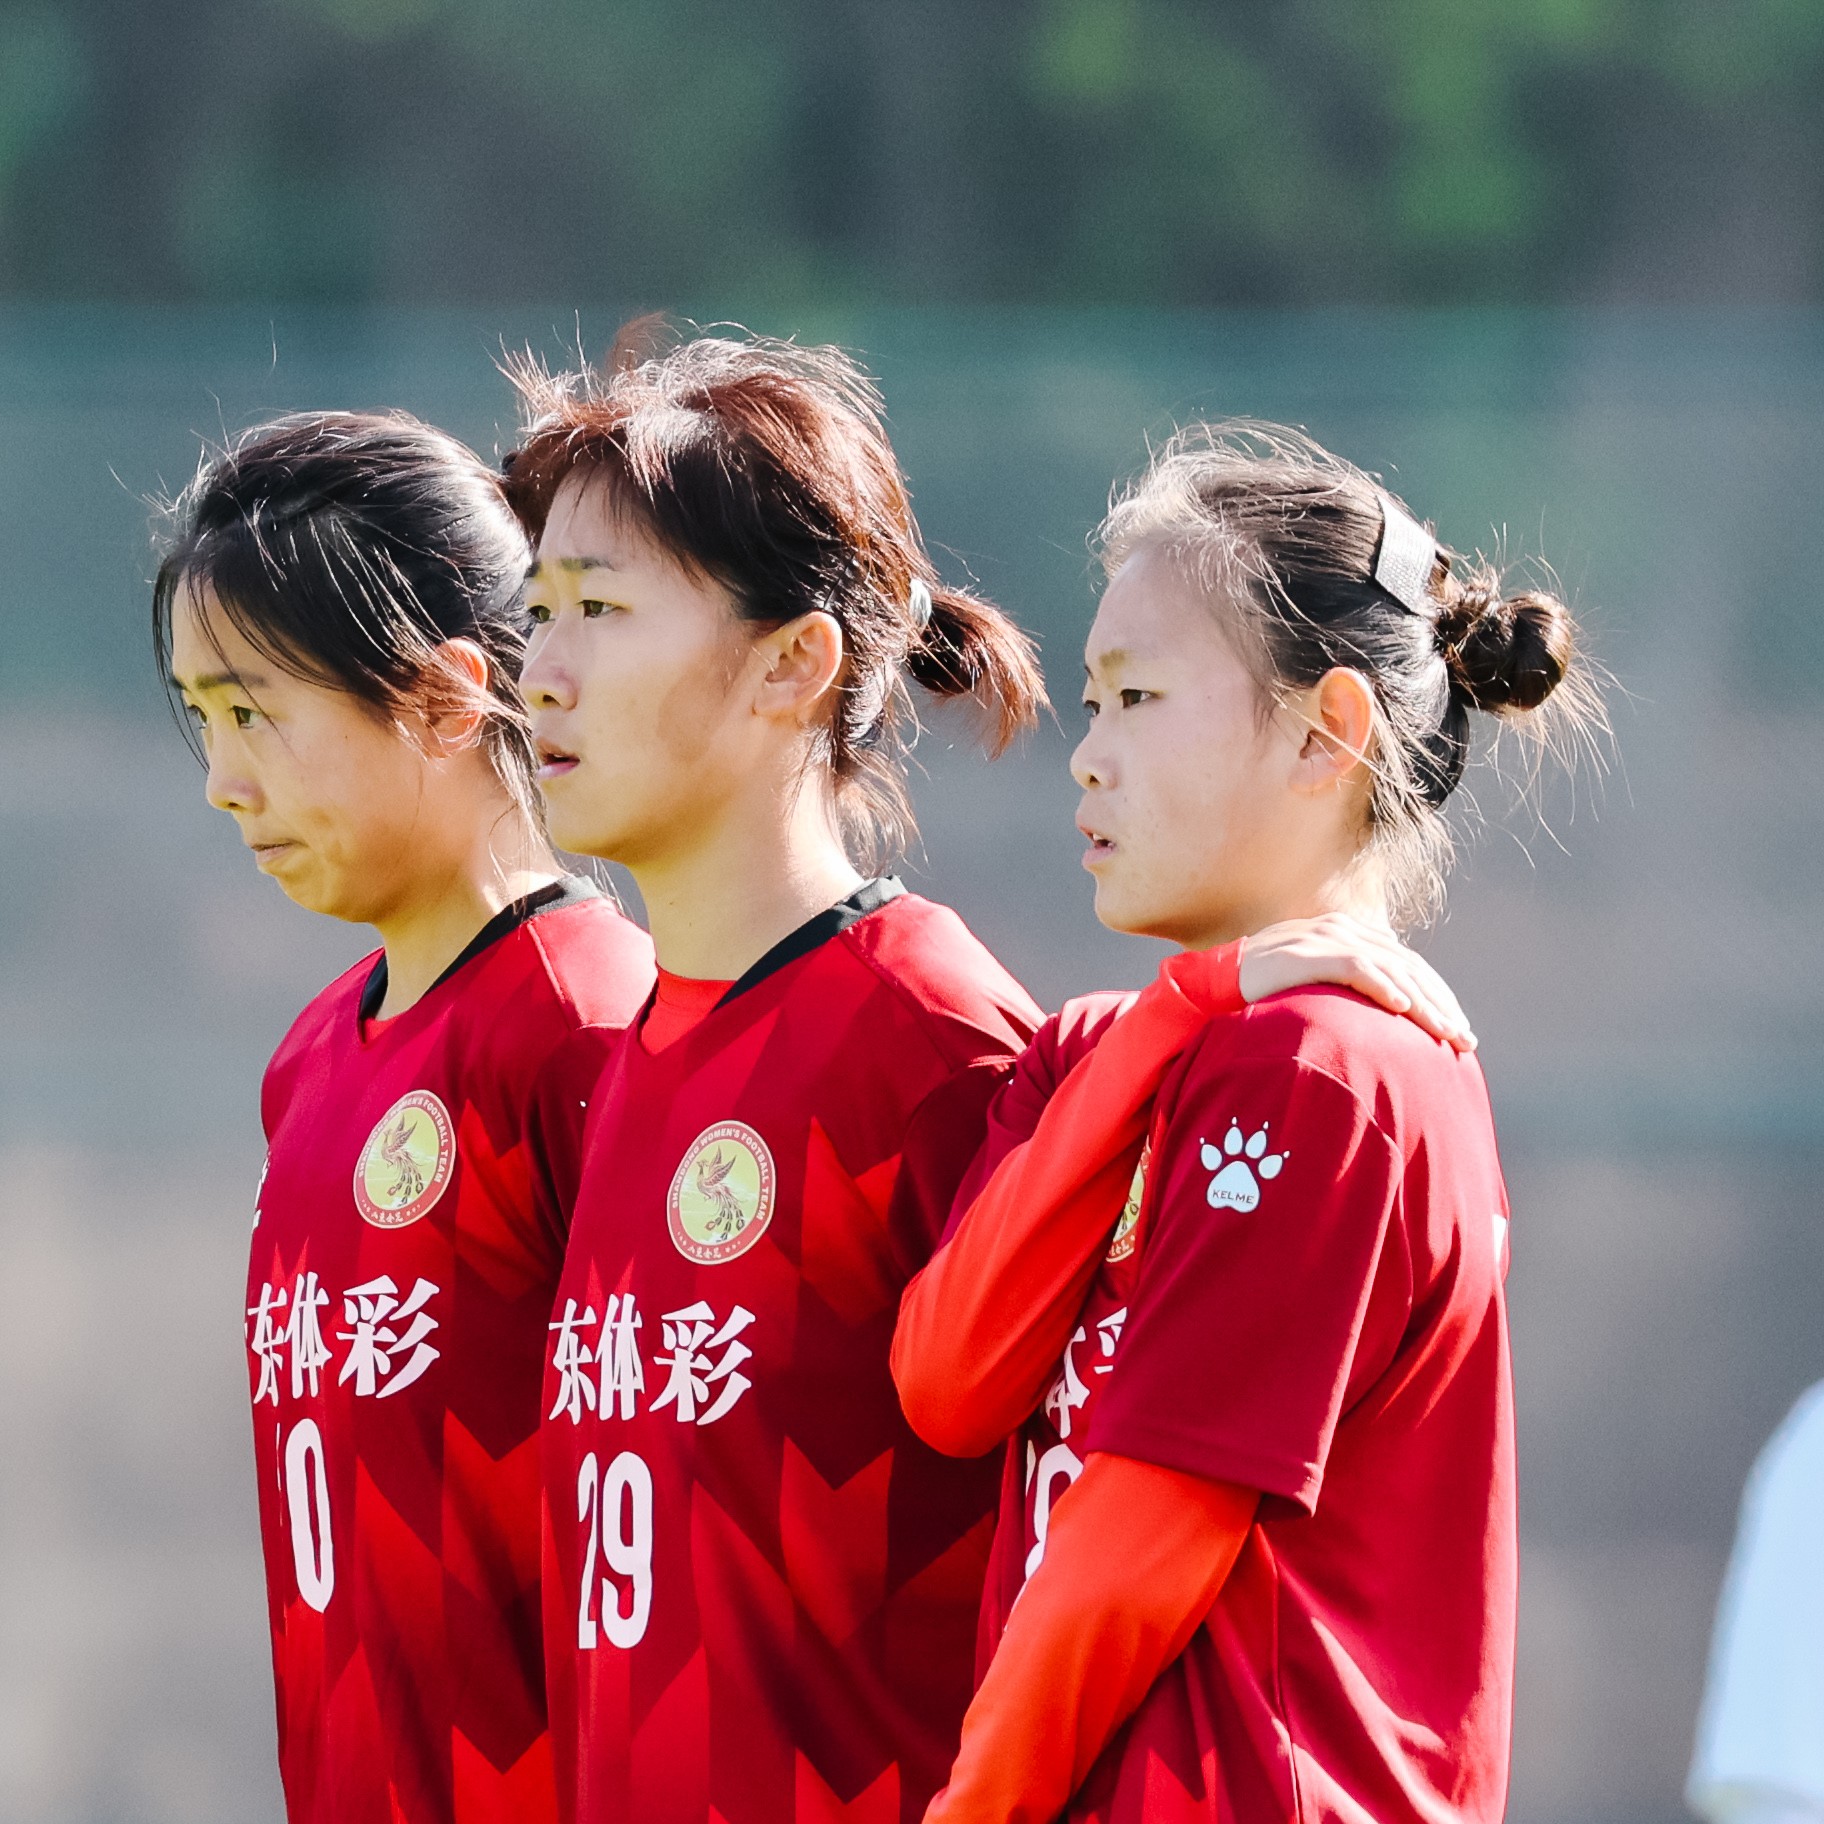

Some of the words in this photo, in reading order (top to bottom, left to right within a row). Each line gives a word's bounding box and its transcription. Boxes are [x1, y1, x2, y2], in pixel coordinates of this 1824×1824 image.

[422, 1098, 449, 1147] FOOTBALL
[434, 1148, 450, 1183] TEAM
[699, 1127, 741, 1147] WOMEN'S
[740, 1132, 770, 1184] FOOTBALL
[756, 1186, 771, 1221] TEAM
[1212, 1188, 1255, 1205] KELME
[244, 1271, 441, 1408] 东体彩
[277, 1417, 335, 1614] 0
[578, 1450, 654, 1650] 29
